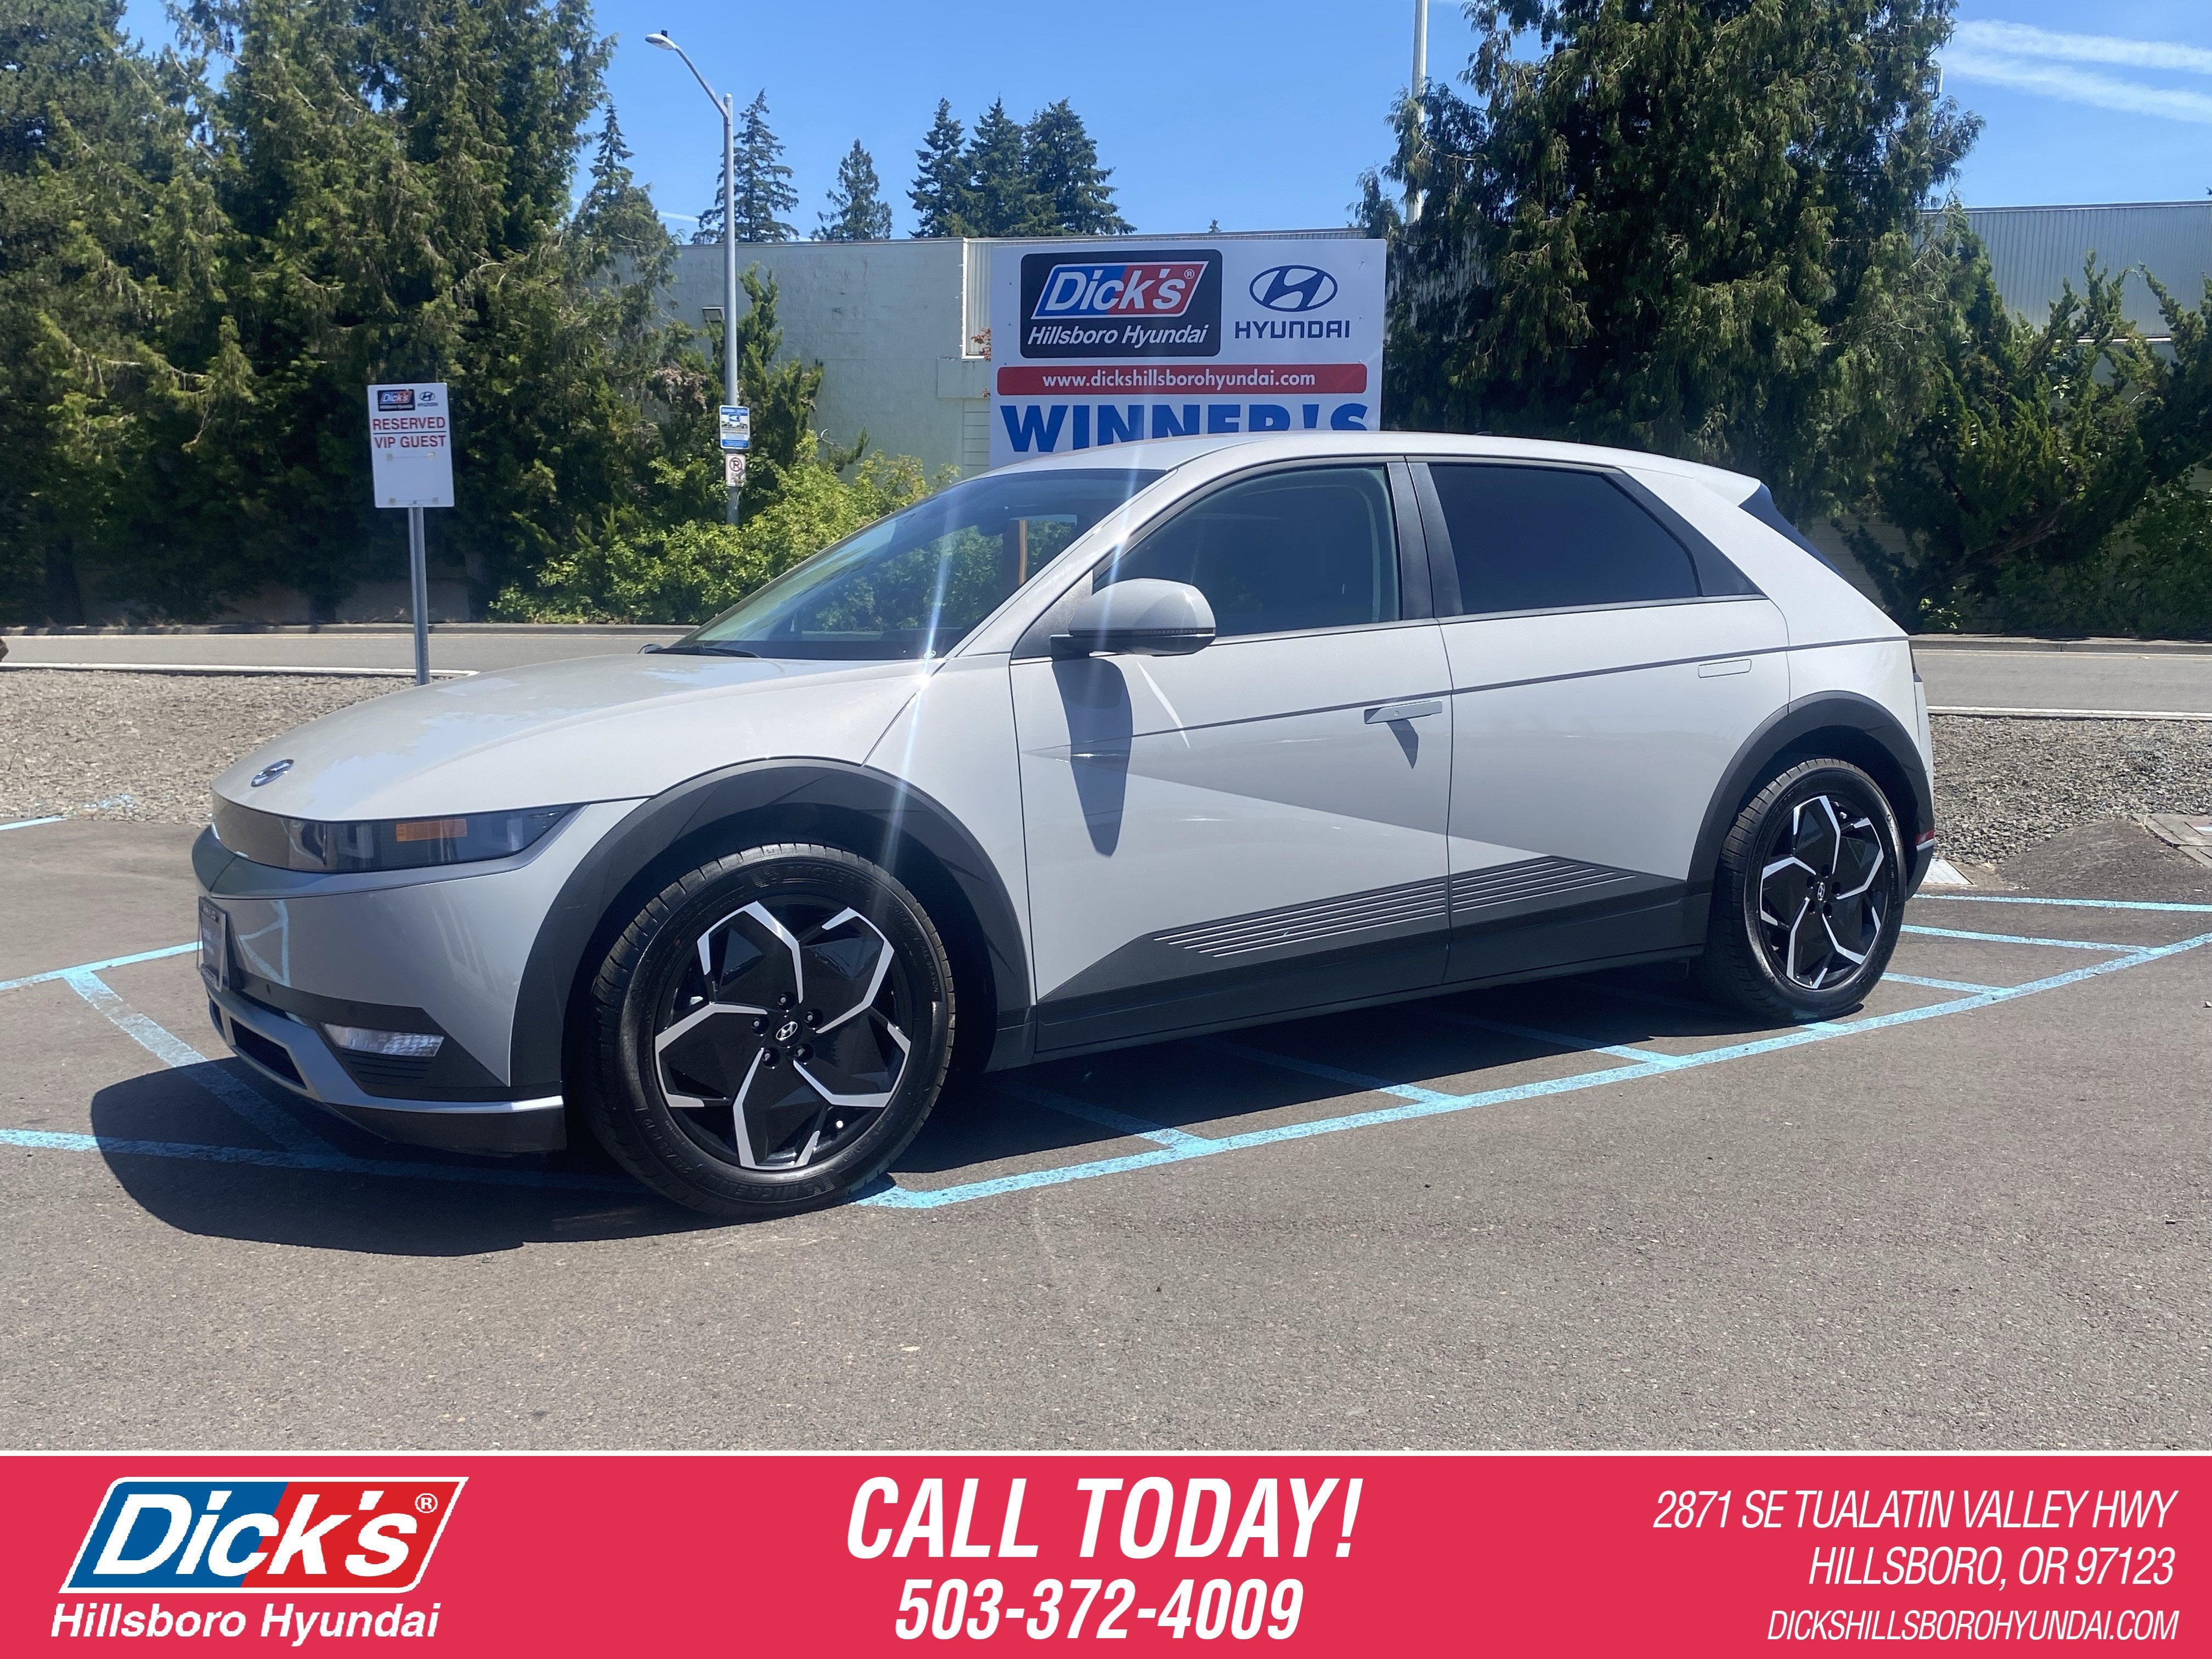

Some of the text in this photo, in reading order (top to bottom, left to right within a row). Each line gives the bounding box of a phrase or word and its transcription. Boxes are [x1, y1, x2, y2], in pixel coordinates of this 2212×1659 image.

[1045, 268, 1187, 311] Dick's
[1028, 324, 1209, 349] Hillsboro Hyundai
[1235, 320, 1350, 338] HYUNDAI
[1043, 370, 1315, 390] www.dickshillsborohyundai.com
[372, 417, 445, 430] RESERVED
[374, 436, 446, 448] VIP GUEST
